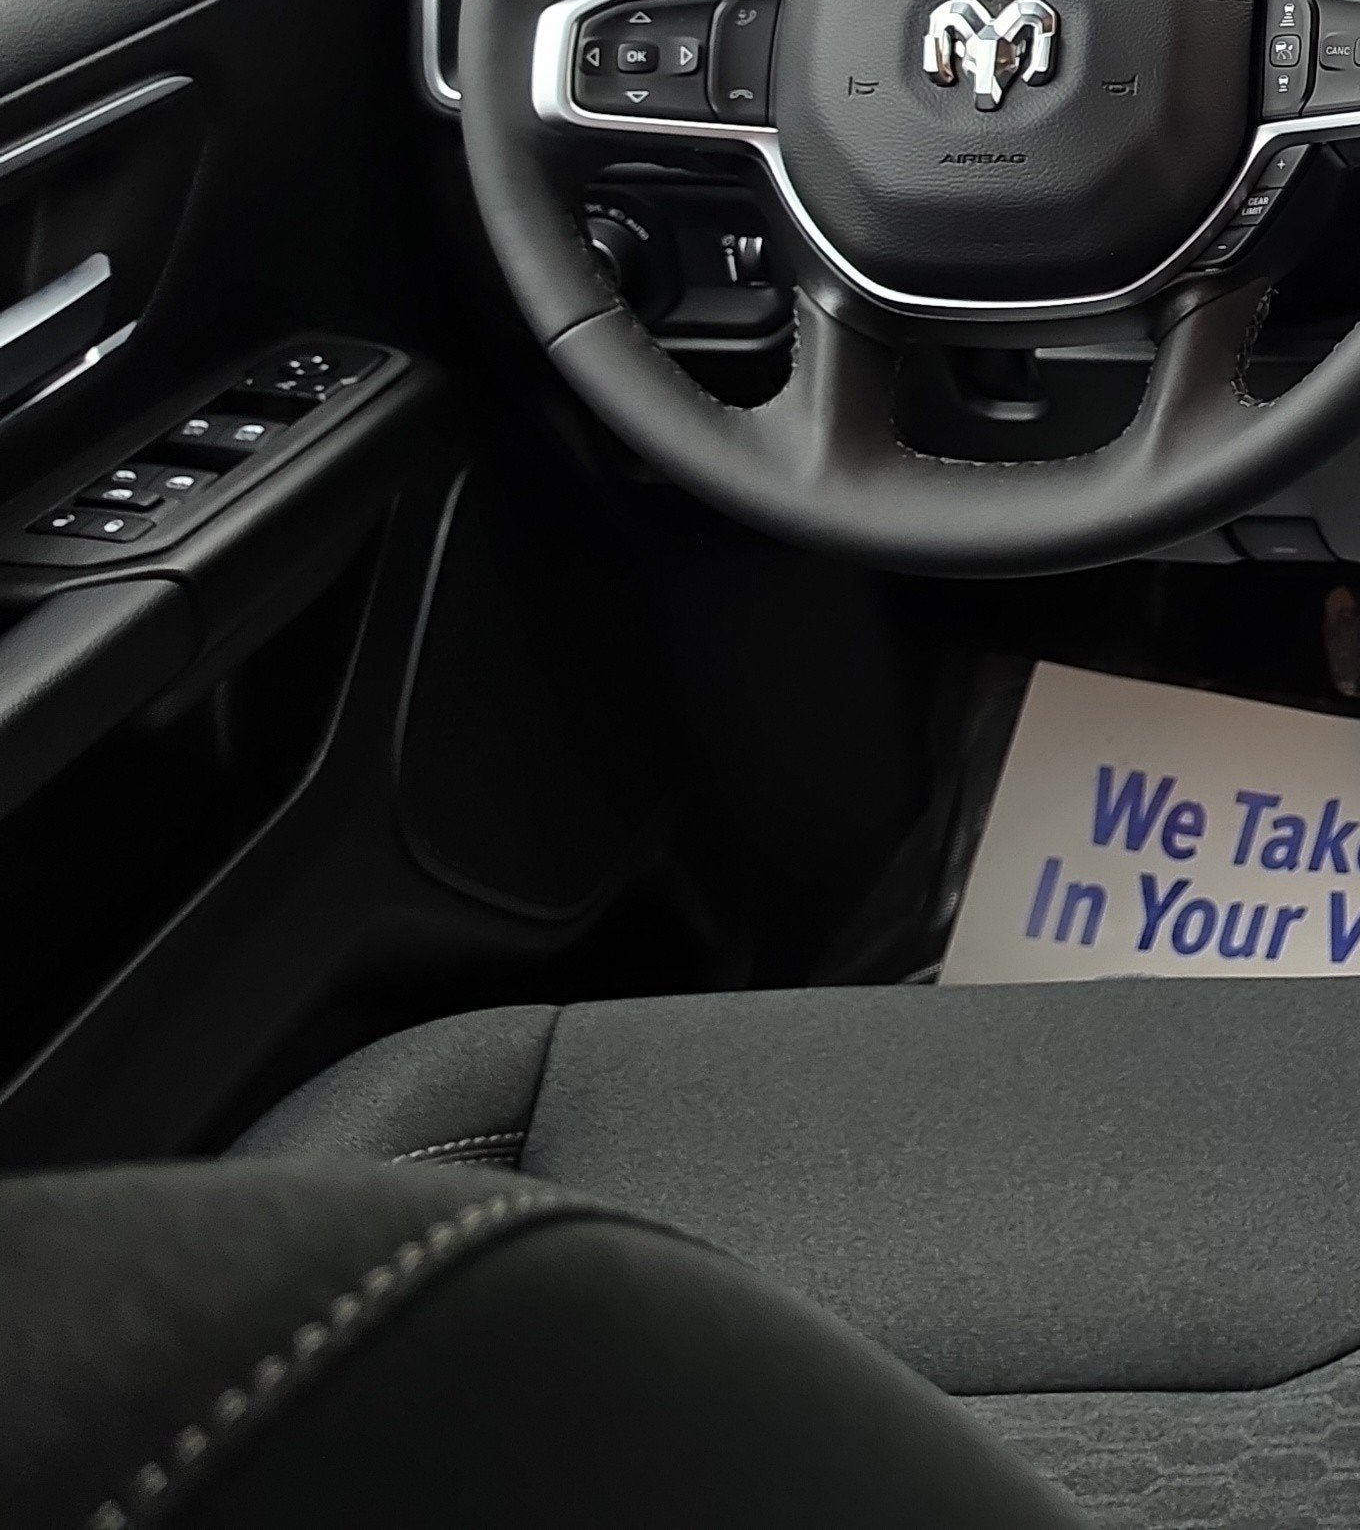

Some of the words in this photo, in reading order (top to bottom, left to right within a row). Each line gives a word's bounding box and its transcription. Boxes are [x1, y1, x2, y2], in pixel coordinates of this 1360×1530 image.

[626, 50, 648, 64] OK
[1326, 45, 1350, 57] CANC
[939, 152, 1028, 165] AIRBAG
[1248, 196, 1269, 206] GEAR
[1242, 206, 1263, 216] LIMIT
[1090, 764, 1208, 861] We
[1025, 857, 1107, 947] In
[1134, 873, 1308, 963] Your
